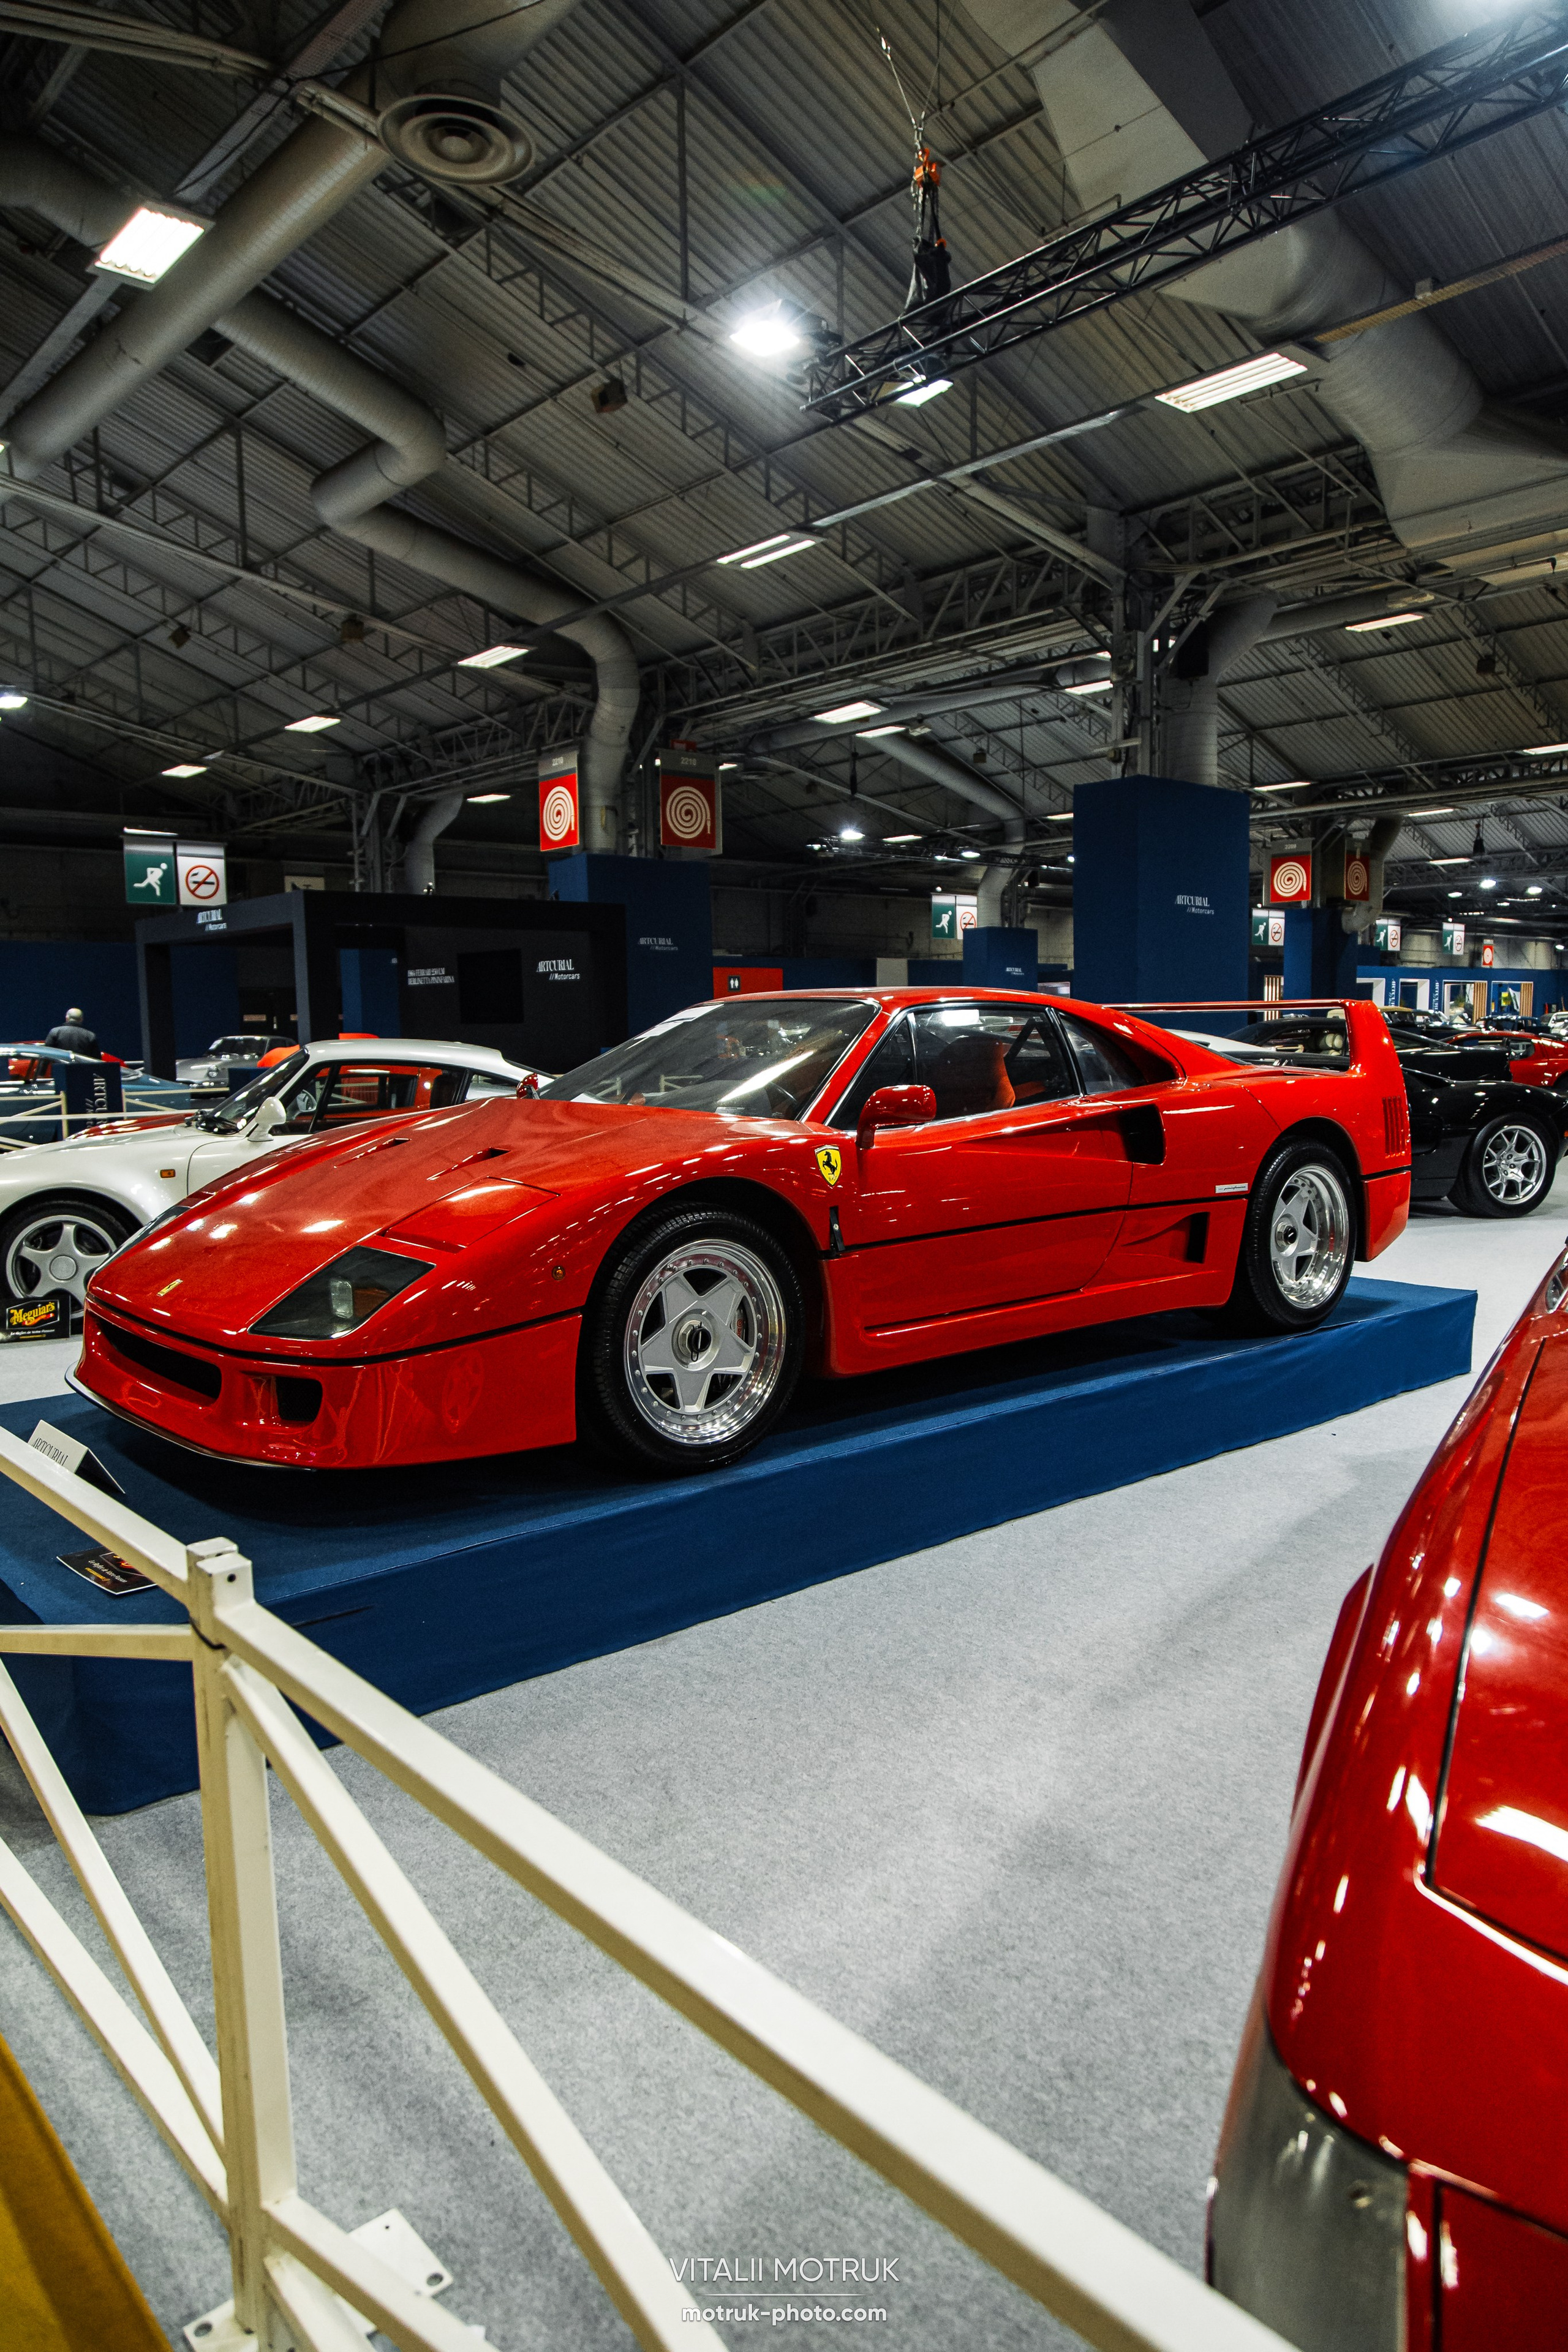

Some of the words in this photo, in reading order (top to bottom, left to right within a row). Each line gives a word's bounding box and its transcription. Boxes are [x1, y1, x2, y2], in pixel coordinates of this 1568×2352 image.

[1175, 895, 1210, 907] ARTCURIAL
[537, 959, 575, 972] ARTCURIAL
[10, 1302, 56, 1325] Meguiar's
